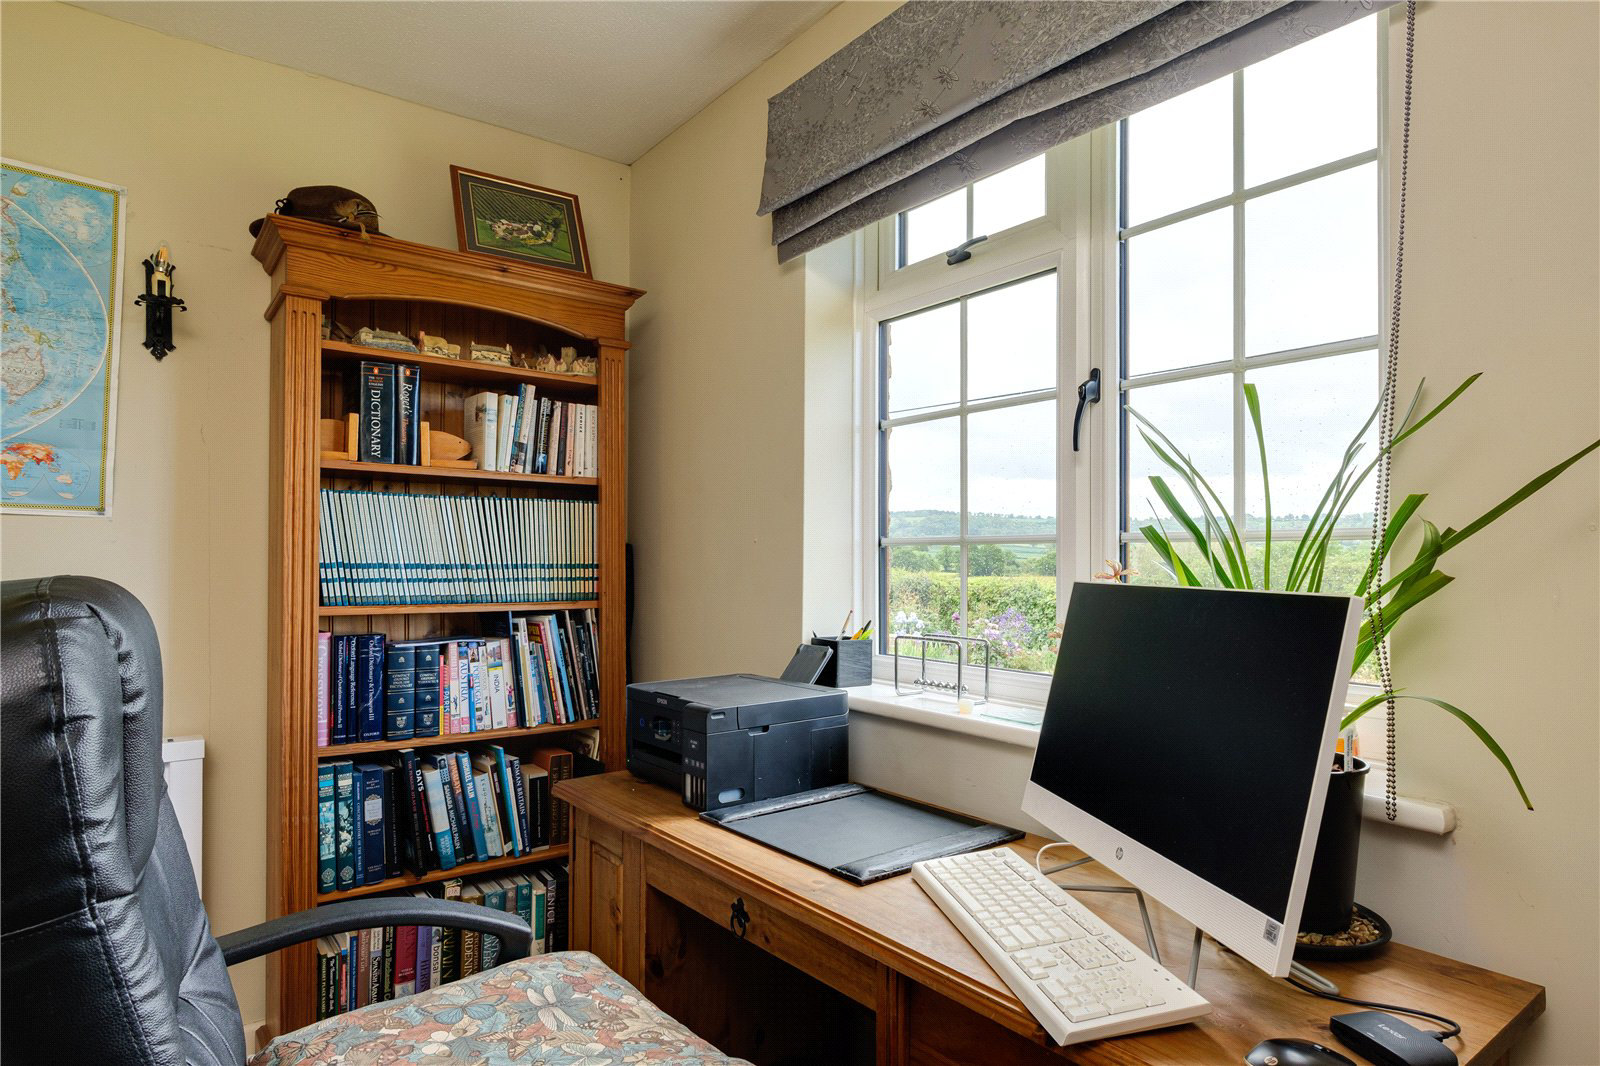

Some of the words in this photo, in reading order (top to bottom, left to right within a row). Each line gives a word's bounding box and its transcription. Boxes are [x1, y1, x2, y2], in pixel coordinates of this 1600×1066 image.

[400, 382, 412, 416] Roget's
[370, 389, 381, 458] DICTIONARY
[416, 770, 424, 792] DAYS
[462, 758, 472, 782] MICHAEL
[444, 784, 453, 809] SAHARA
[466, 783, 475, 798] PALIN
[516, 787, 525, 815] BRITAIN
[449, 810, 458, 833] MICHAEL
[452, 833, 461, 849] PALIN
[464, 932, 473, 976] ARDENIN
[372, 957, 380, 982] SPANISH
[420, 960, 430, 991] HERBS
[1377, 1023, 1407, 1040] Lexar
